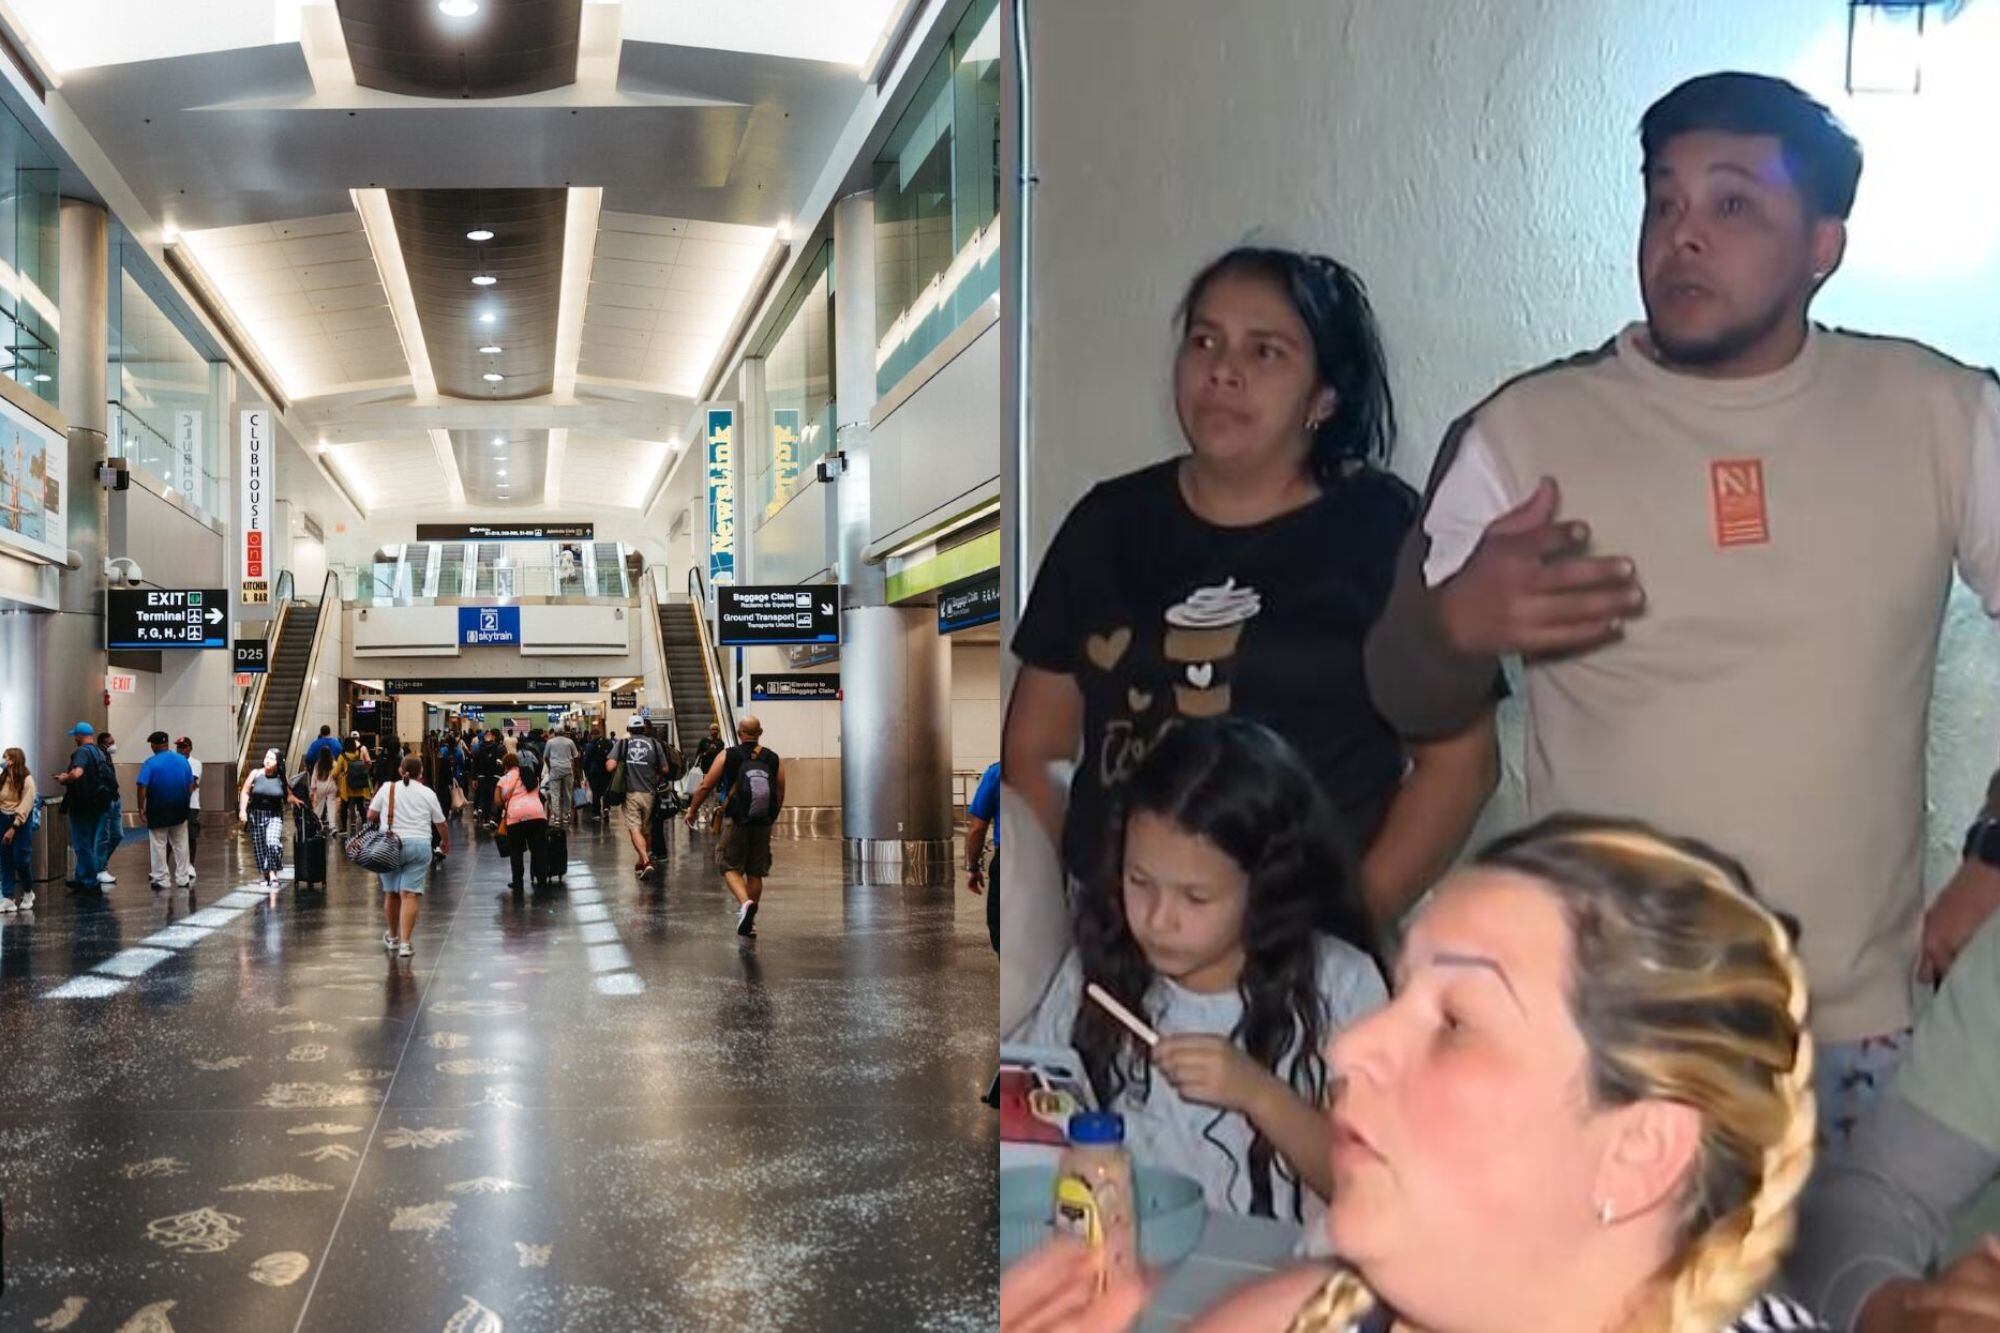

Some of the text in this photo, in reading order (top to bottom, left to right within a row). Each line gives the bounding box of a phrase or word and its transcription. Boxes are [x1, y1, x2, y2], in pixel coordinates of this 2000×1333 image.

[249, 414, 260, 576] CLUBHOUSE one
[243, 581, 268, 591] KITCHEN
[148, 592, 185, 606] EXIT
[254, 592, 268, 602] BAR
[733, 592, 795, 603] Baggage Claim
[136, 611, 185, 622] Terminal
[485, 615, 495, 629] 2
[723, 613, 795, 623] Ground Transport
[138, 628, 185, 640] F, G, H, J
[479, 631, 513, 642] skytrain
[238, 649, 263, 660] D25
[112, 677, 131, 690] EXIT
